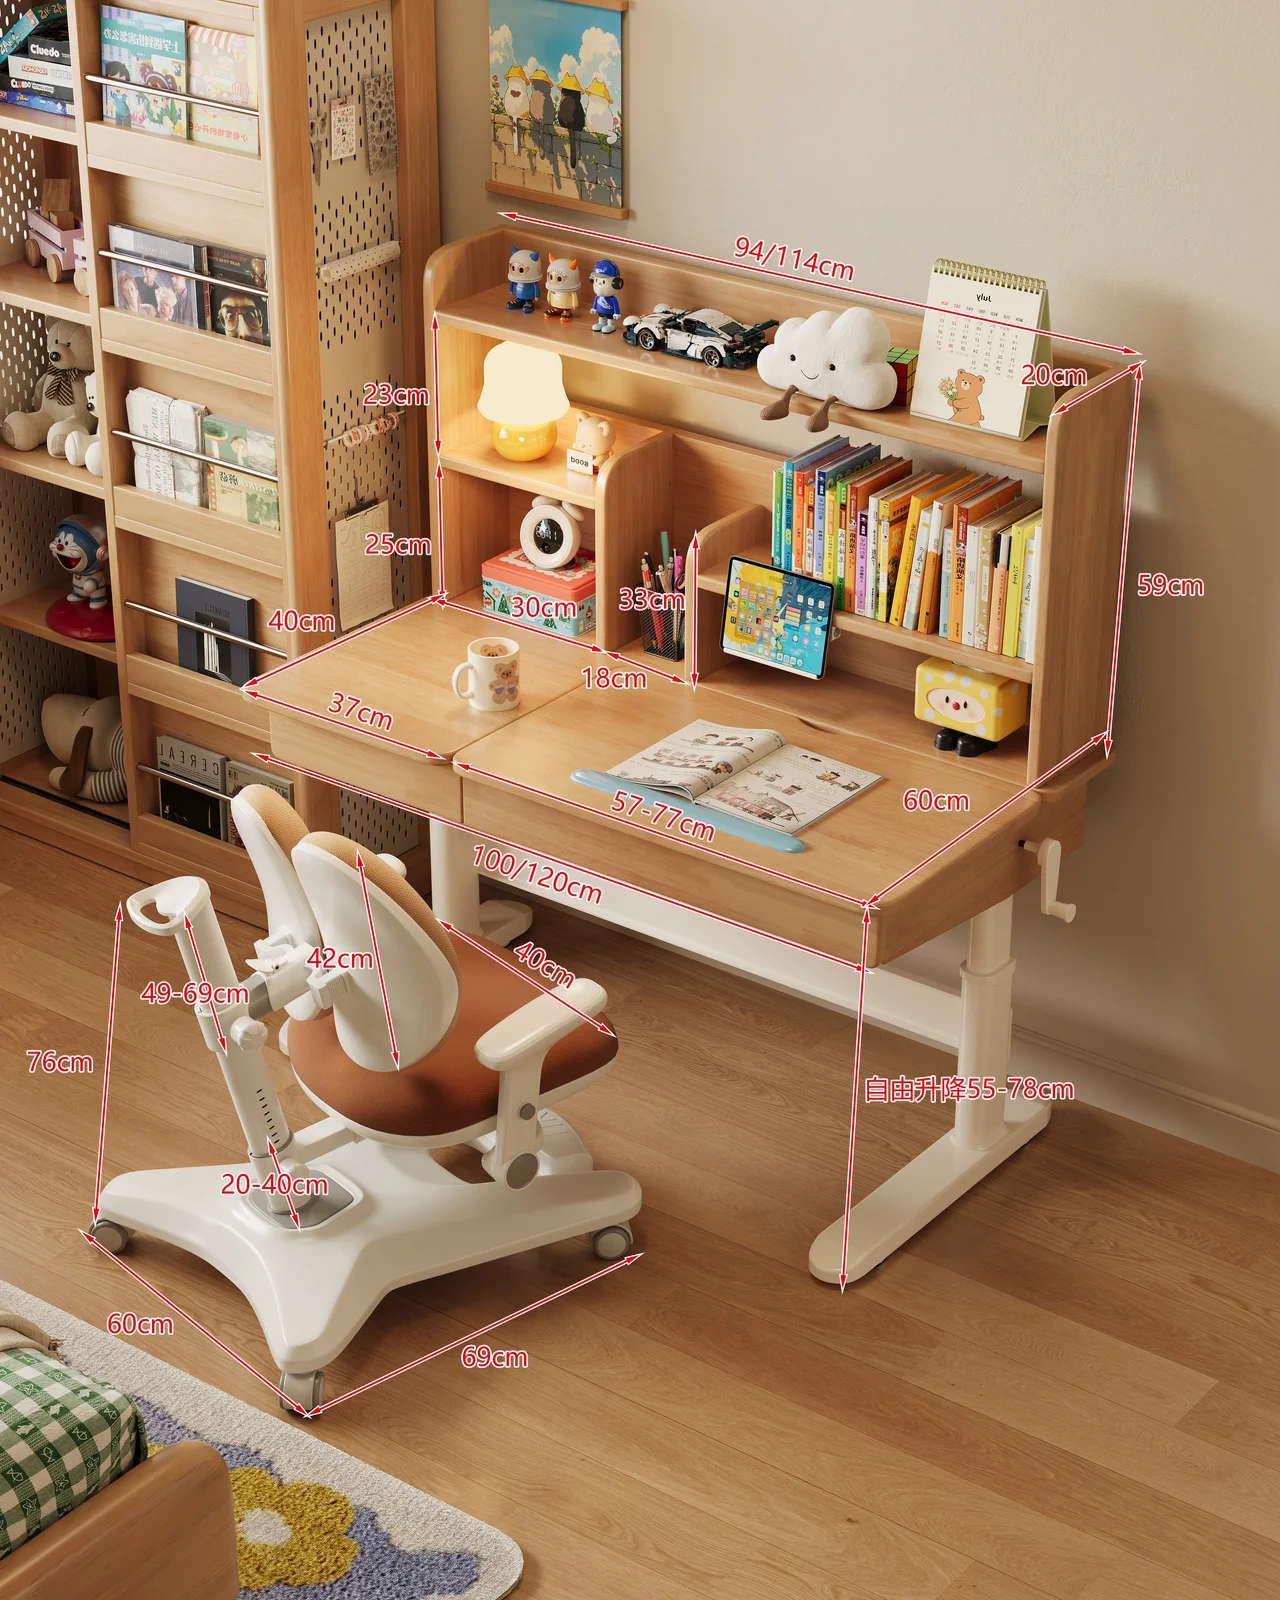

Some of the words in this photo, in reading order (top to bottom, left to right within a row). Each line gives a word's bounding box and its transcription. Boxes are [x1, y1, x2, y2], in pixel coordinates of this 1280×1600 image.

[30, 43, 60, 58] Cluedo
[22, 65, 48, 75] MONOPOLY
[10, 79, 31, 89] CLUEDO
